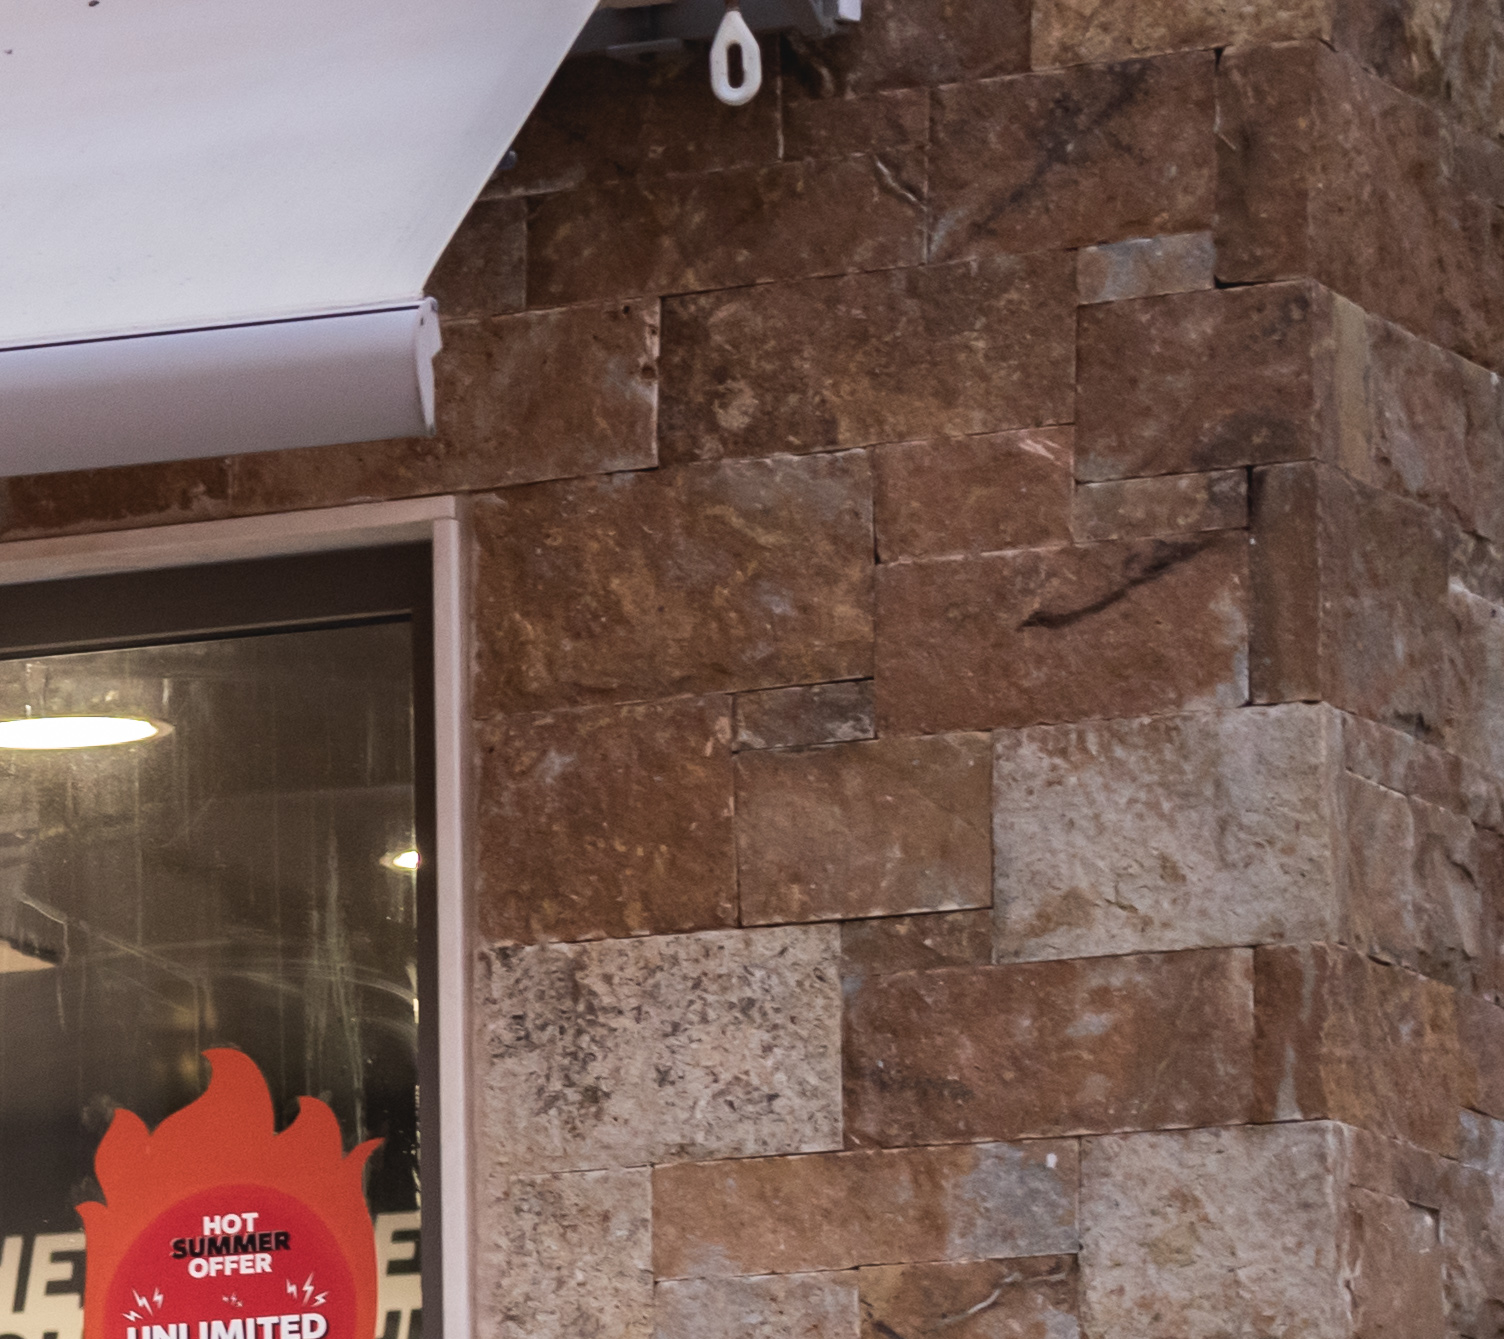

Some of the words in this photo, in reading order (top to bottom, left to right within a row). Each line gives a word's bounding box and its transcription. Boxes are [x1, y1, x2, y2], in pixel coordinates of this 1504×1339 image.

[202, 1212, 259, 1236] HOT
[170, 1231, 291, 1259] SUMMER
[188, 1253, 273, 1279] OFFER
